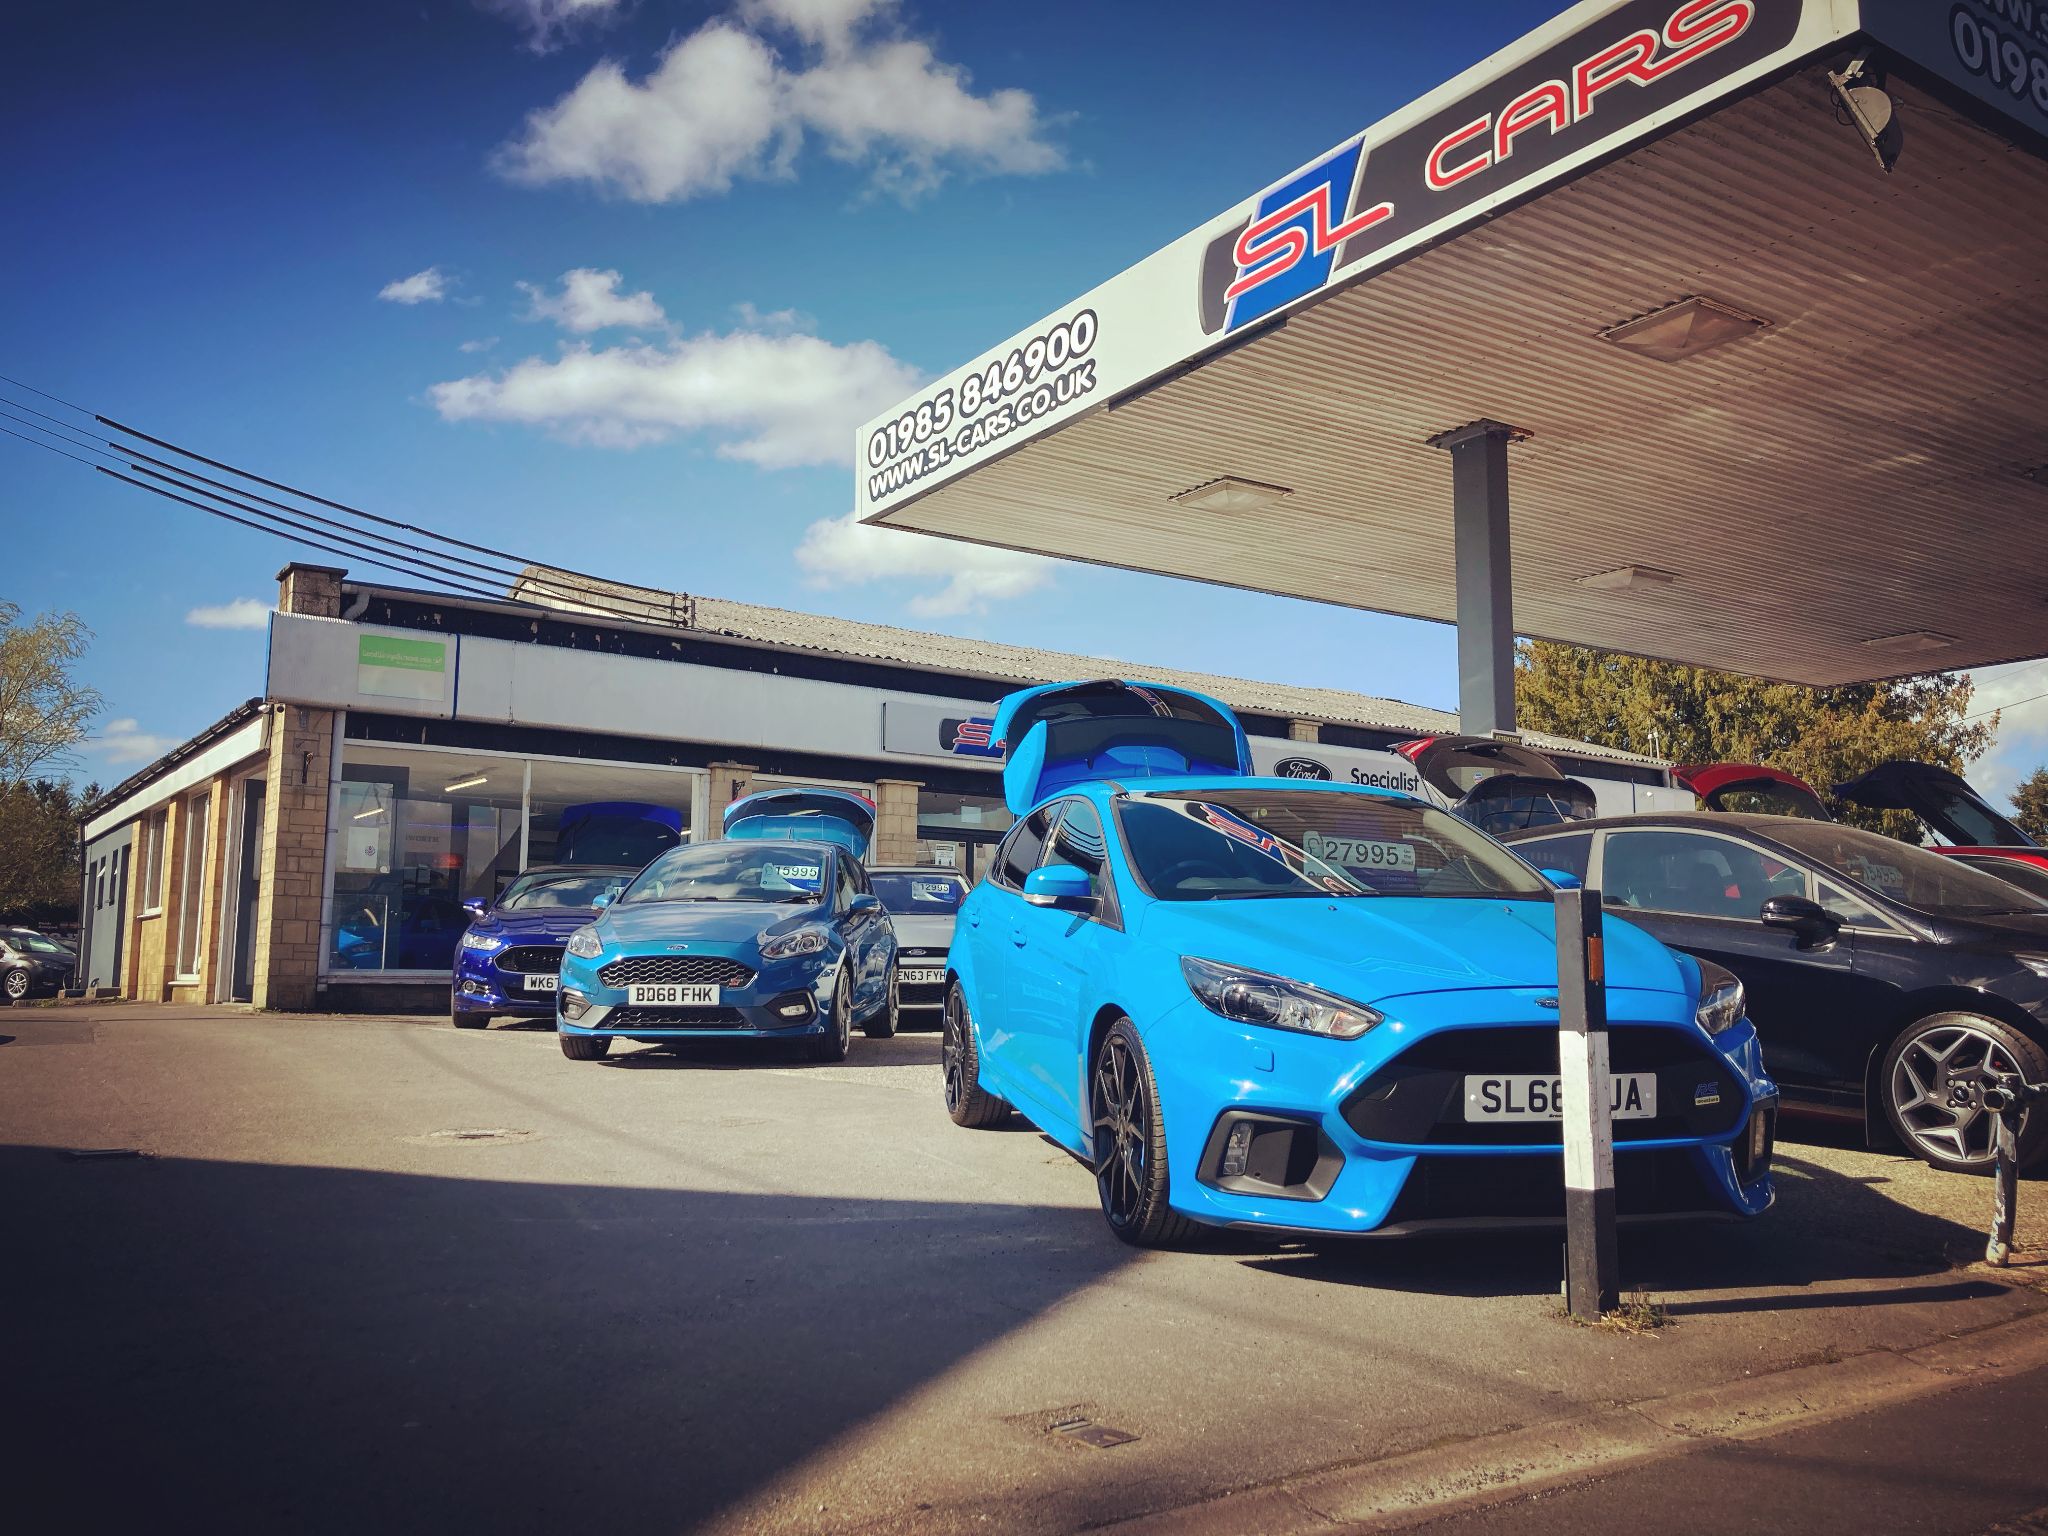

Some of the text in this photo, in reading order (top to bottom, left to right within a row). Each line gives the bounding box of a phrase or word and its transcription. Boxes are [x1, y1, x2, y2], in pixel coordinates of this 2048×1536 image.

[1223, 0, 1756, 304] SL CARS
[869, 309, 1098, 468] 01985 846900
[869, 359, 1096, 502] WWW.SL-CARS.CO.UK
[1286, 761, 1321, 780] Ford
[1350, 768, 1420, 792] Specialist
[898, 970, 924, 981] EN63
[635, 987, 713, 1002] BD68 FHK
